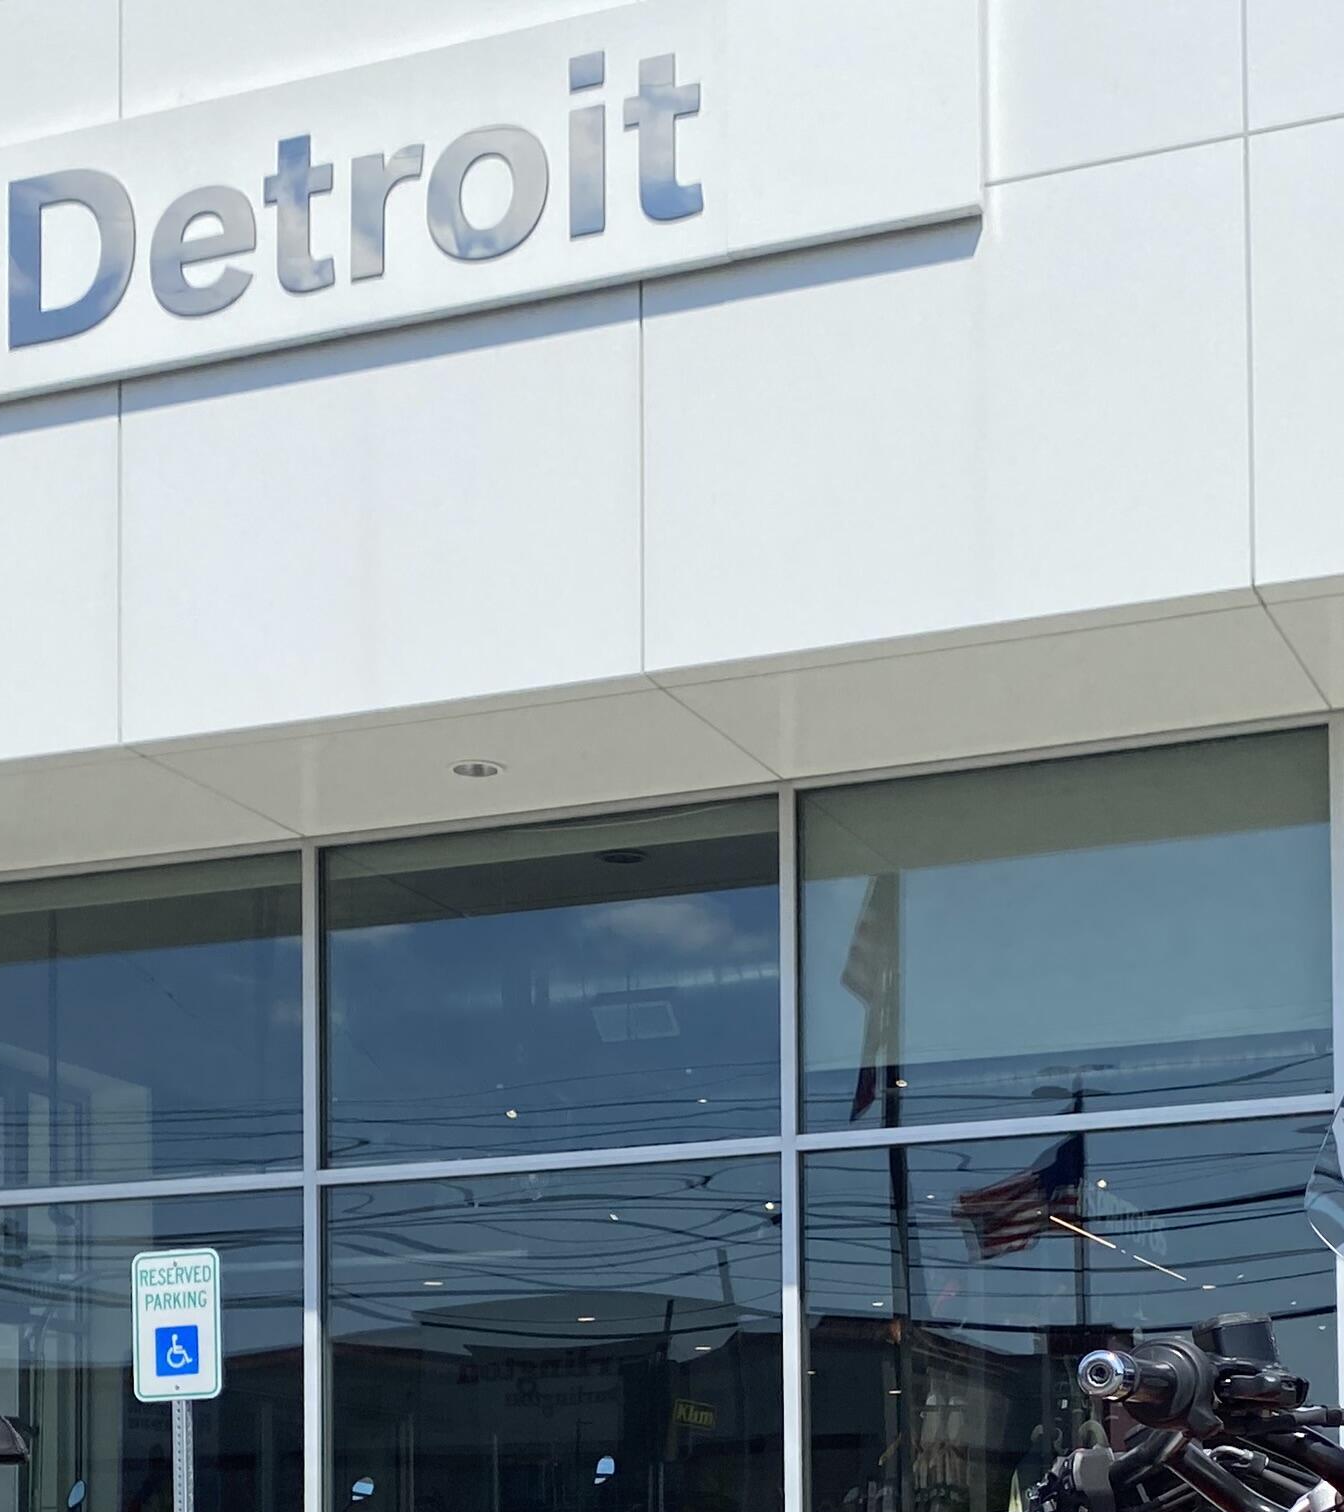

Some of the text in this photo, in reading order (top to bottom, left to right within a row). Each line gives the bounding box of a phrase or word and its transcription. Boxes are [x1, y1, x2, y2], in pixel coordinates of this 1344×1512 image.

[8, 50, 703, 351] Detroit
[140, 1264, 212, 1287] RESERVED
[145, 1290, 208, 1312] PARKING
